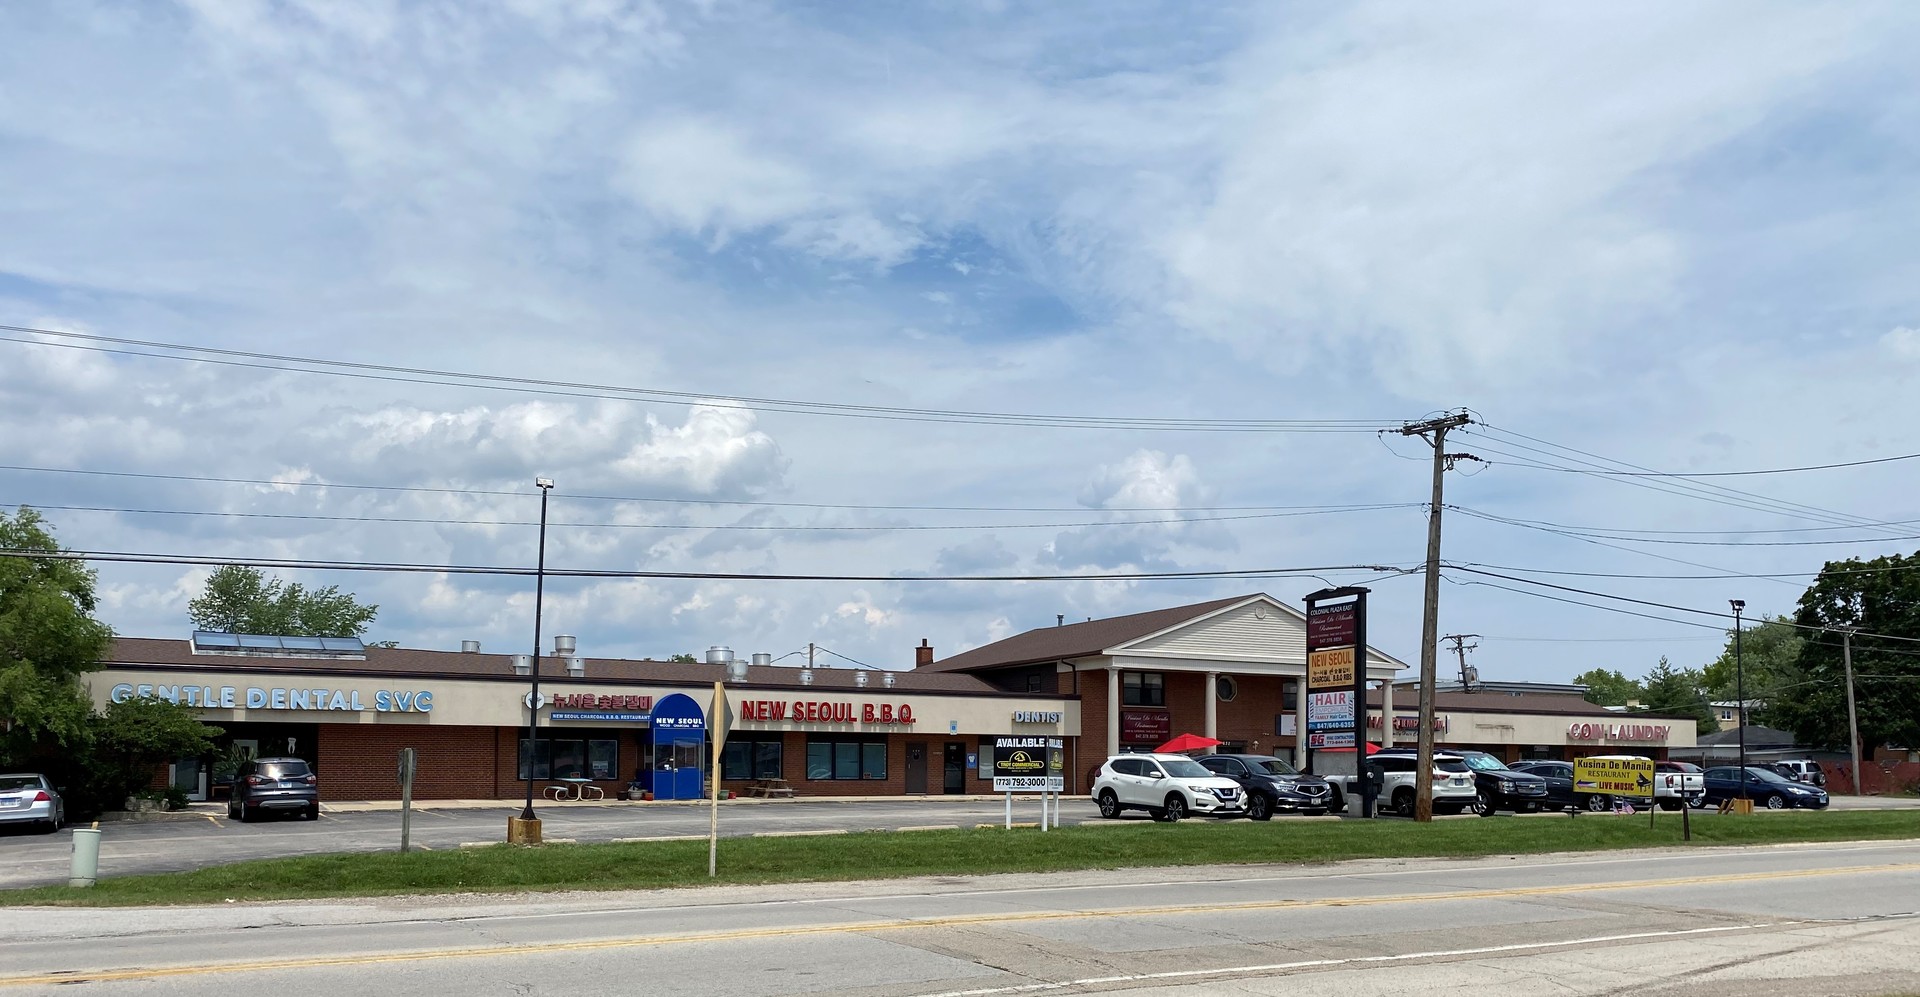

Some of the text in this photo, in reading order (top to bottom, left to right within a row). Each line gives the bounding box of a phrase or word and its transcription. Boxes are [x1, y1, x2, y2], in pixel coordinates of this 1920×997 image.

[1311, 651, 1352, 668] NEW SEOUL
[111, 683, 434, 713] GENTLE DENTAL SVC
[553, 693, 595, 709] 뉴서울
[1315, 693, 1346, 706] HAIR
[741, 700, 917, 725] NEW SEOUL B.B.Q.
[1014, 710, 1063, 723] DENTIST
[1569, 722, 1671, 741] COIN LAUNDRY
[996, 738, 1045, 748] AVAILABLE
[1577, 759, 1652, 771] Kusina De Manila
[1587, 770, 1631, 779] RESTAURANT
[996, 778, 1011, 786] (773)
[1012, 778, 1046, 787] 792-3000
[1599, 781, 1635, 791] LIVE MUSIC
